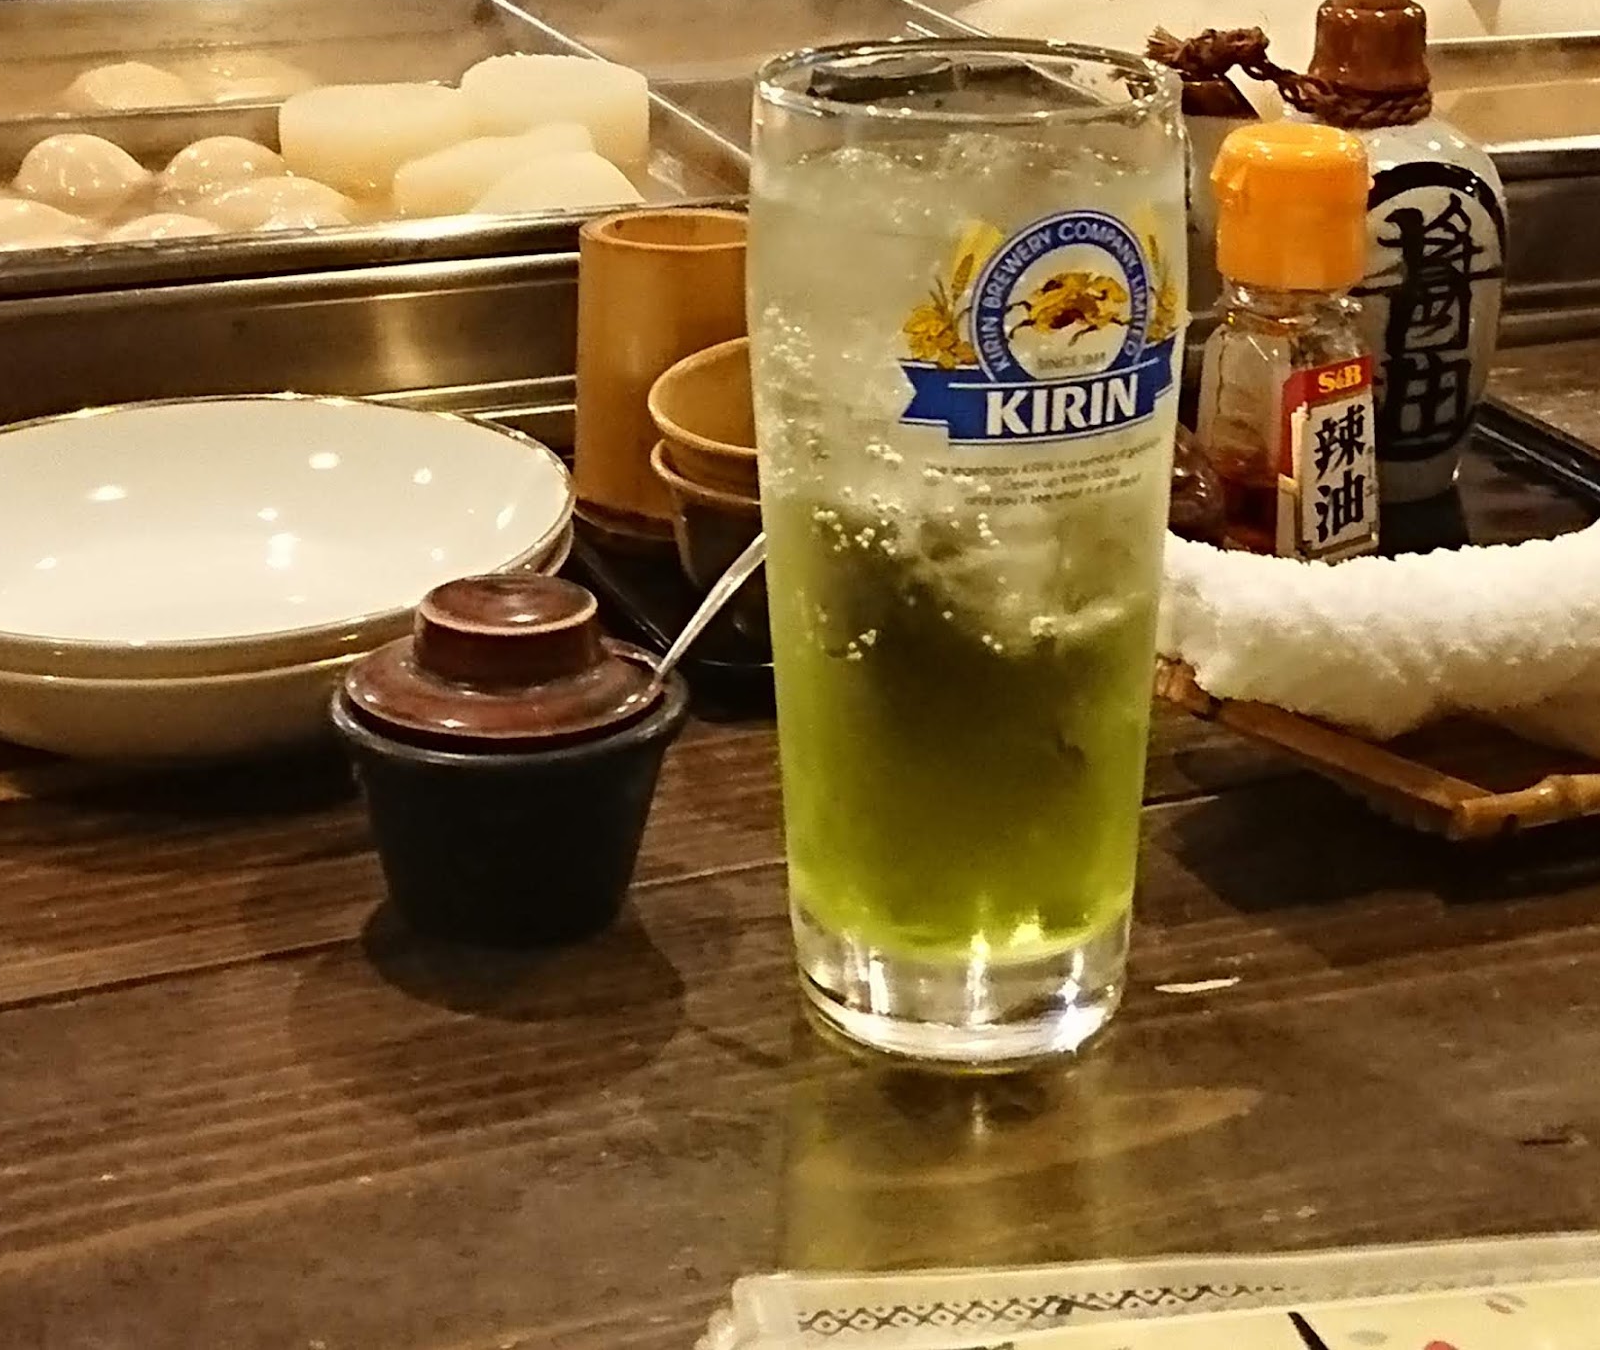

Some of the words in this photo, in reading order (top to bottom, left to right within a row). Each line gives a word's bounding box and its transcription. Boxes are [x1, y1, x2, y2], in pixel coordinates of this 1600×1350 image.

[982, 229, 1053, 310] BREWERY
[982, 317, 1012, 374] KIRIN
[1122, 274, 1147, 358] LIMITED
[985, 372, 1139, 437] KIRIN
[1318, 364, 1363, 394] S&B
[1312, 402, 1366, 545] 辣油
